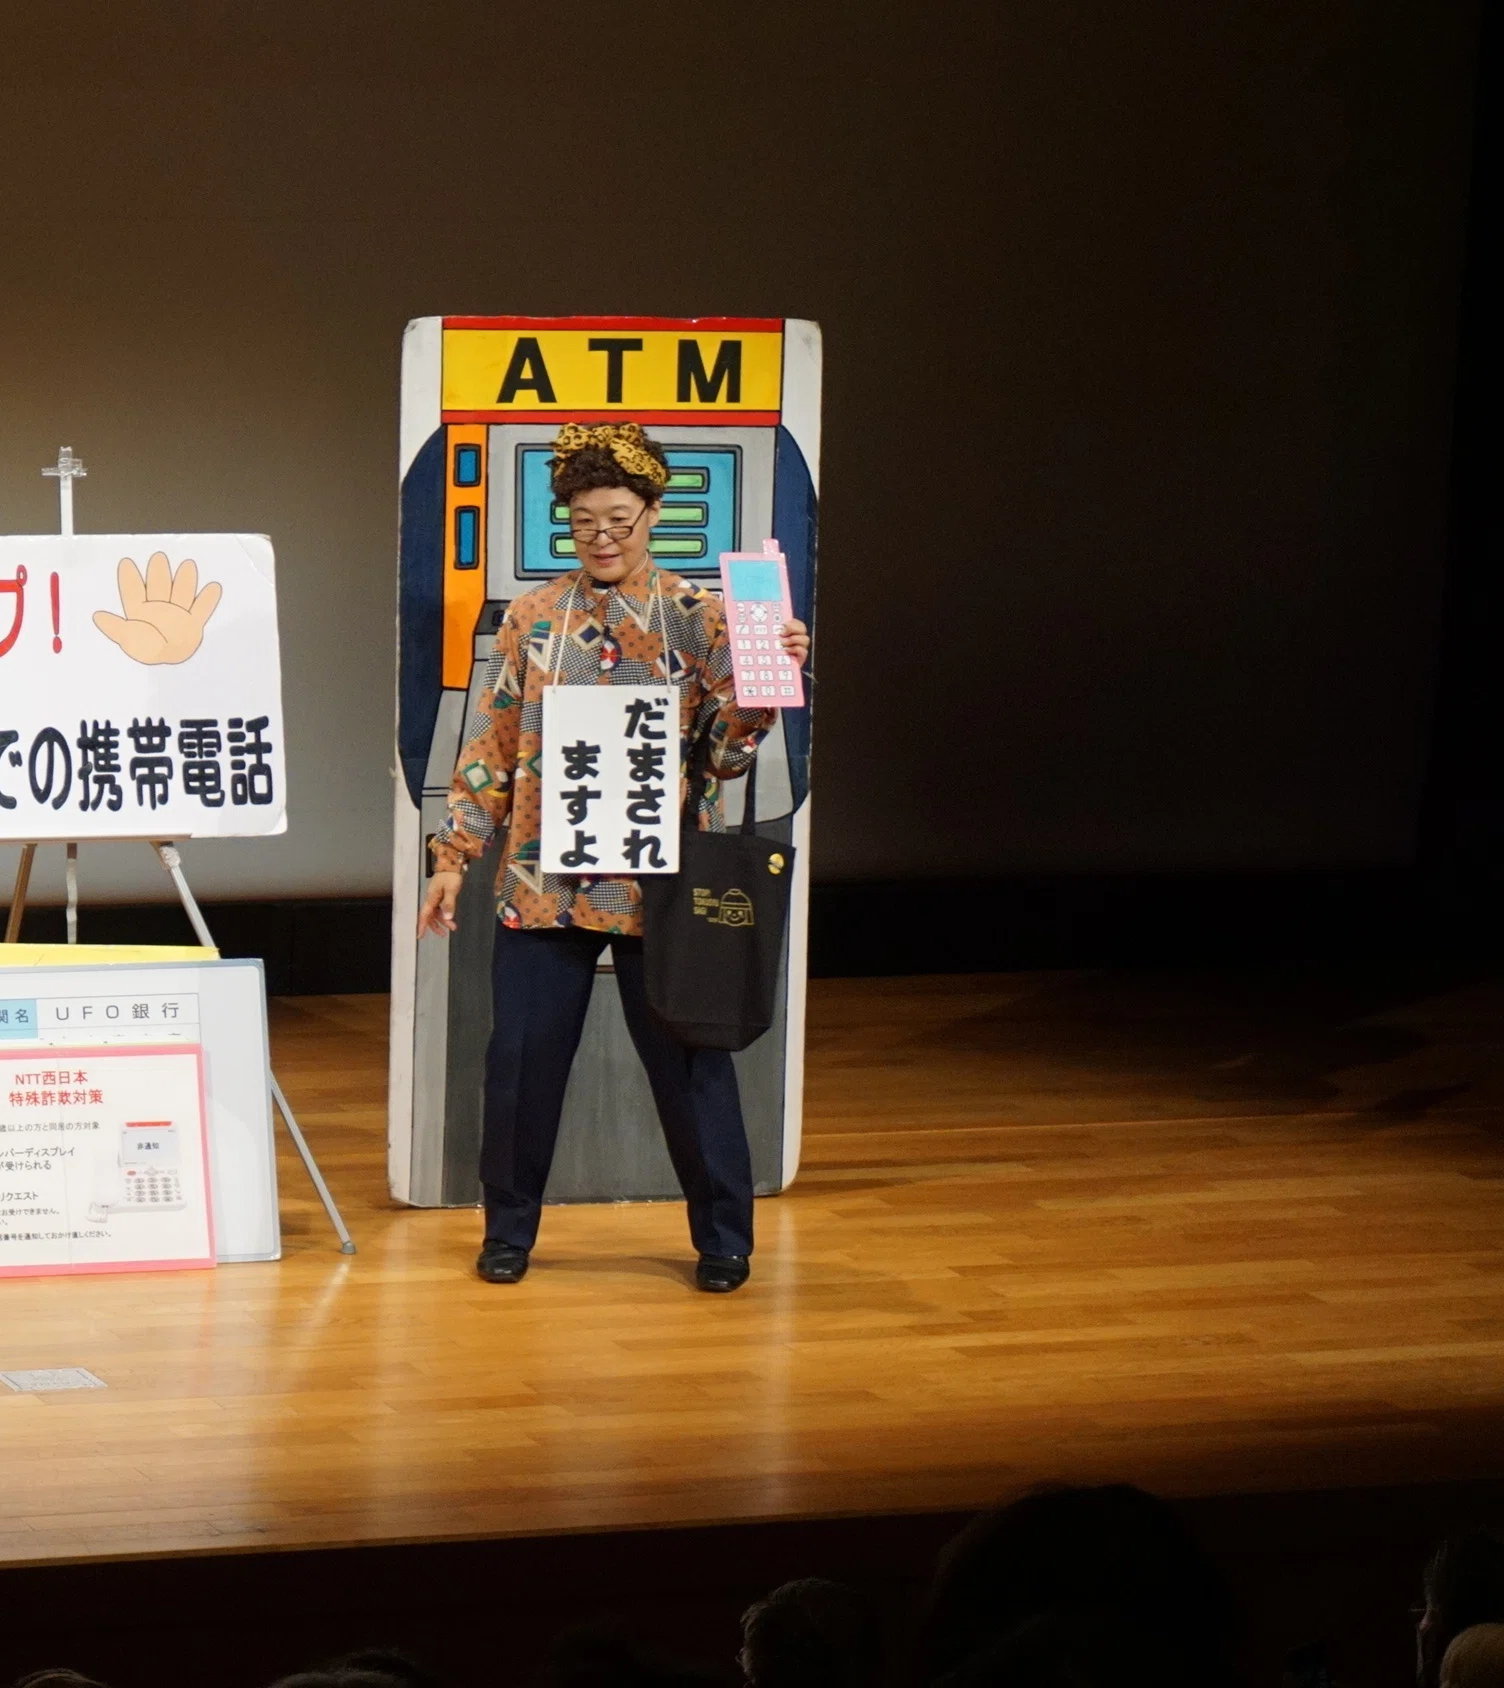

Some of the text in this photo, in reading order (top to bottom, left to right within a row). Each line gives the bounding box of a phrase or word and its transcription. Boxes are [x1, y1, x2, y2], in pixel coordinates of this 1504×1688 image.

[496, 336, 742, 404] ATM
[559, 739, 602, 868] ますよ
[621, 697, 670, 870] だまされ
[56, 1002, 180, 1021] UFO銀行
[9, 1088, 104, 1107] 特殊詐欺対策
[15, 1069, 88, 1086] NTT西日本
